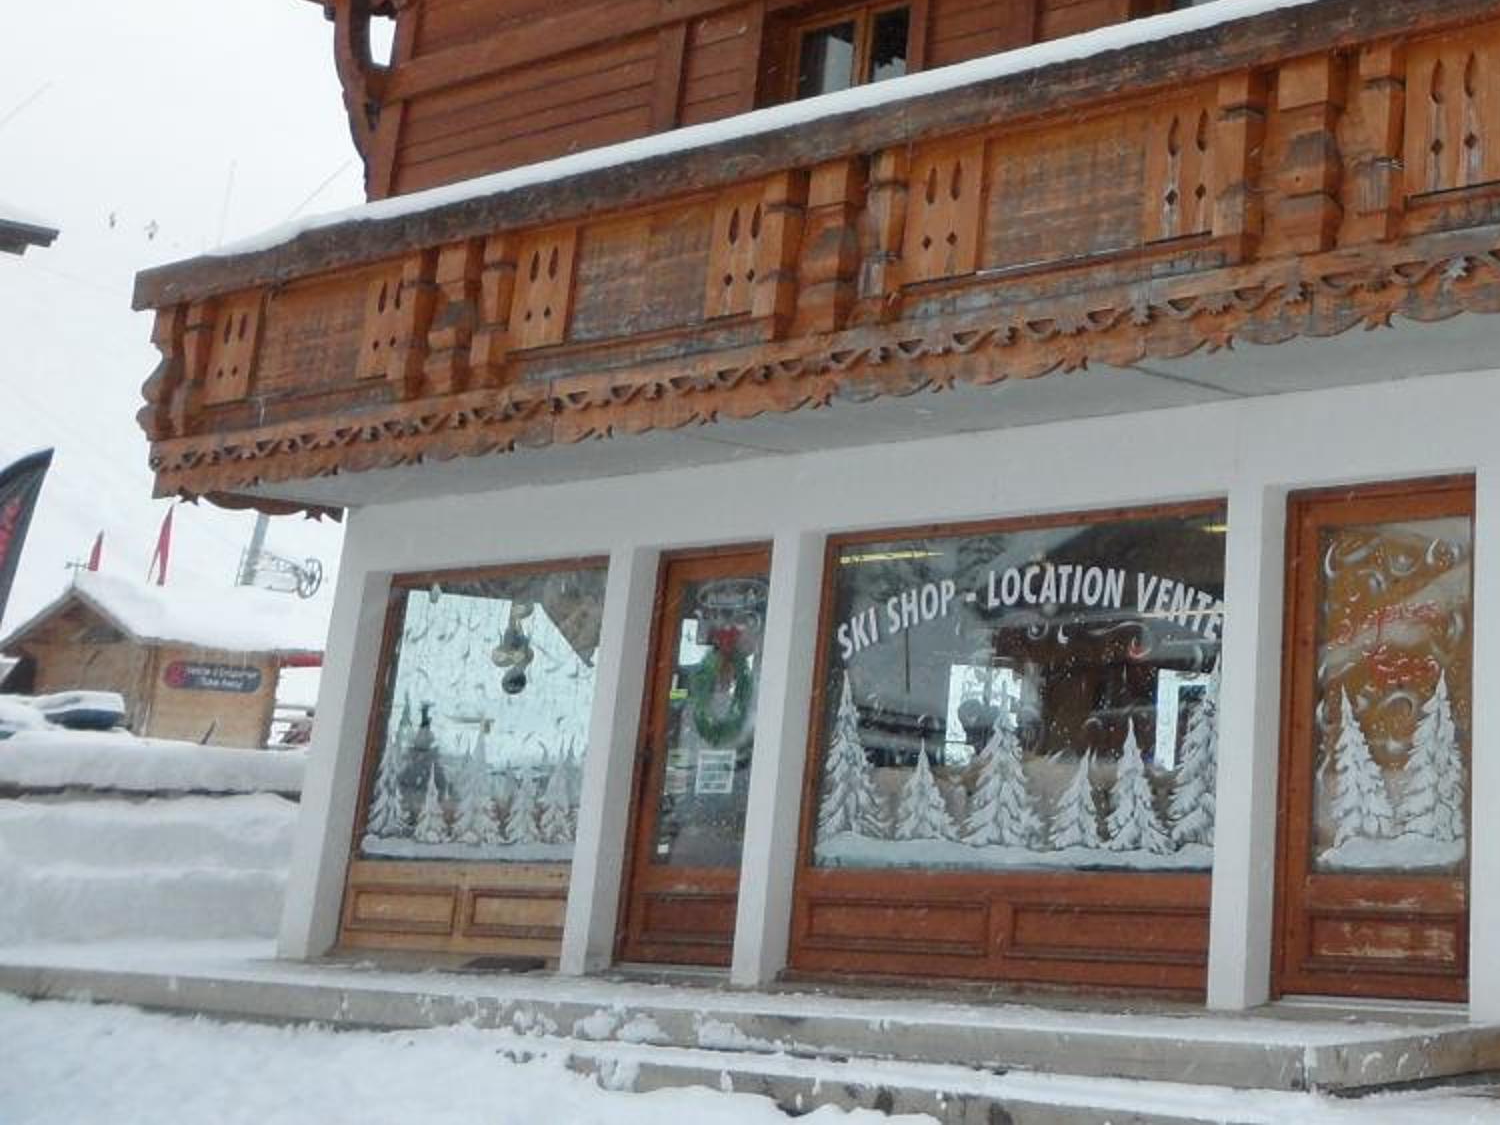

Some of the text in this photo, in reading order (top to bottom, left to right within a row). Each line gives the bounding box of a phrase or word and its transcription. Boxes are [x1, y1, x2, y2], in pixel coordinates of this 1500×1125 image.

[837, 606, 879, 661] SKI
[887, 579, 956, 635] SHOP
[988, 562, 1126, 611] LOCATION
